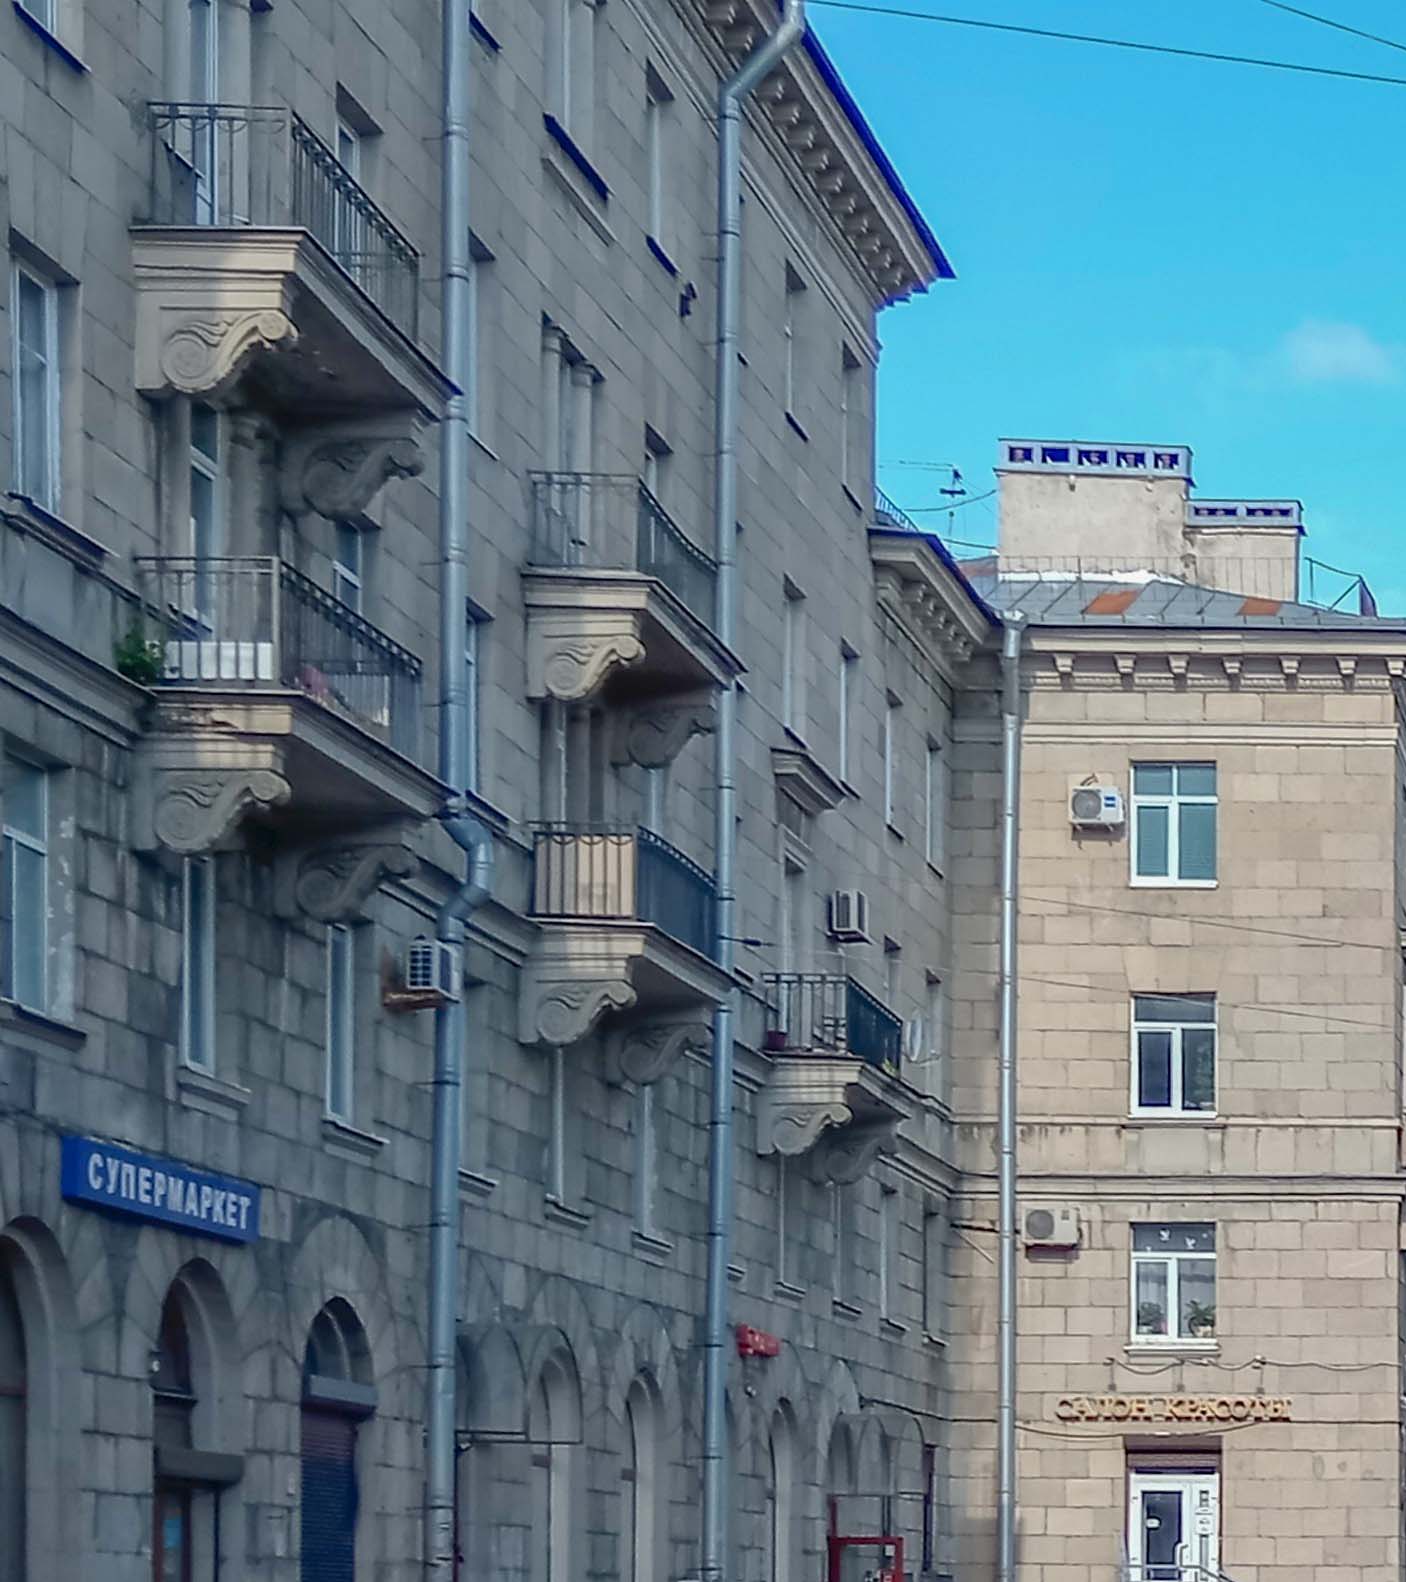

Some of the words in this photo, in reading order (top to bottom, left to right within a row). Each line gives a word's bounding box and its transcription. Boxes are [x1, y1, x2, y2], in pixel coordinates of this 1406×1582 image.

[88, 1153, 252, 1230] СУПЕРМАРКЕТ
[1056, 1398, 1151, 1422] САЛОН
[1167, 1398, 1292, 1422] КРАСОТЫ
